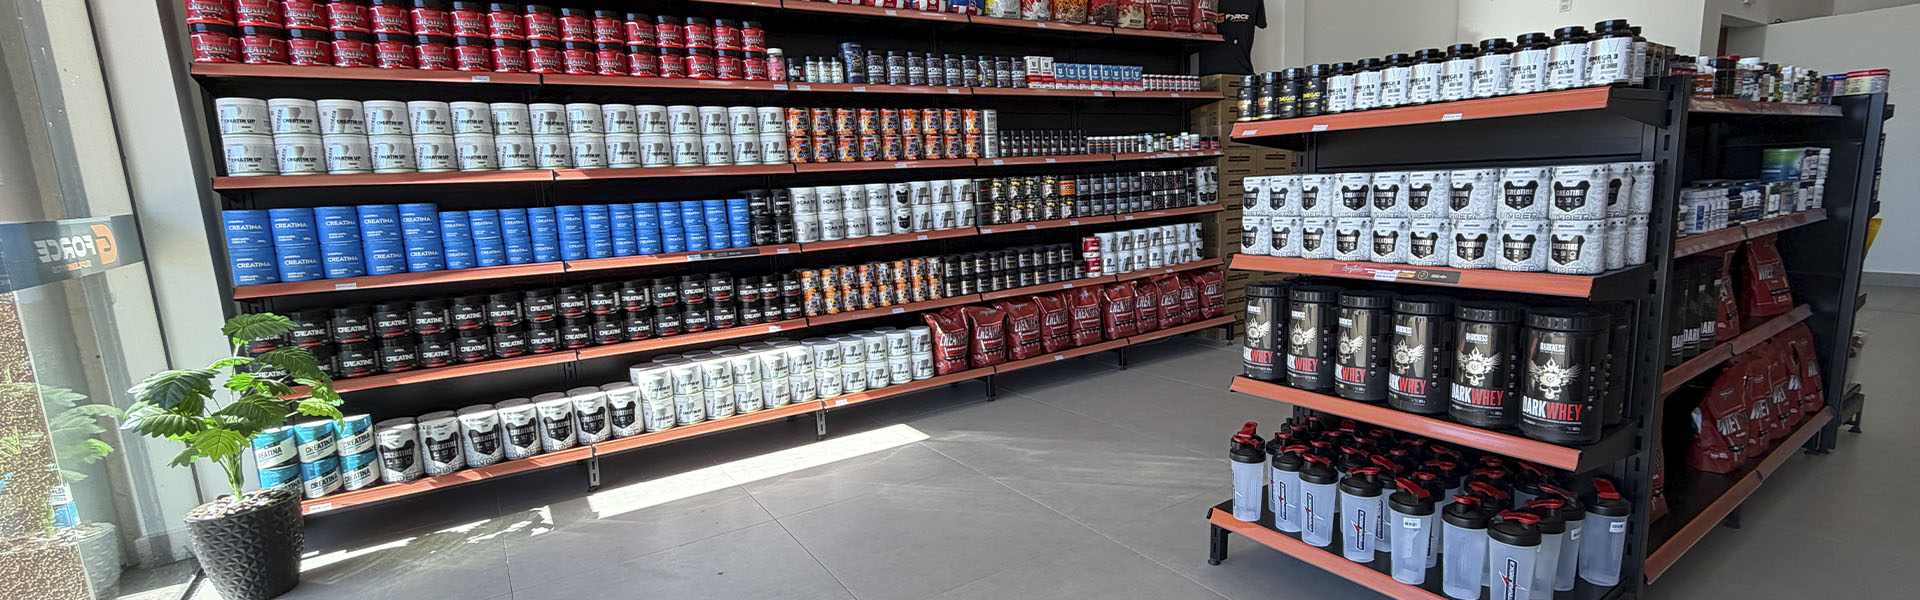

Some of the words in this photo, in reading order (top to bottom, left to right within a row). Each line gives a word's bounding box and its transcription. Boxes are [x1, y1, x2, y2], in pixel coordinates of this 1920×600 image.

[530, 304, 554, 312] CREATINE
[455, 312, 482, 320] CREATINE
[379, 319, 408, 327] CREATINE
[338, 325, 368, 333] CREATINE
[628, 324, 649, 332] CREATINE
[294, 328, 325, 337] CREATINE
[565, 332, 588, 340] CREATINE
[531, 337, 555, 345] CREATINE
[461, 344, 487, 352] CREATINE
[386, 353, 414, 362] CREATINE
[423, 350, 449, 358] CREATINE
[344, 358, 373, 367] CREATINE
[1523, 395, 1583, 421] DARKWHEY
[343, 433, 370, 448] CREATINA
[306, 438, 333, 453] CREATINA
[344, 469, 370, 482] CREATINA
[311, 473, 338, 489] CREATINA
